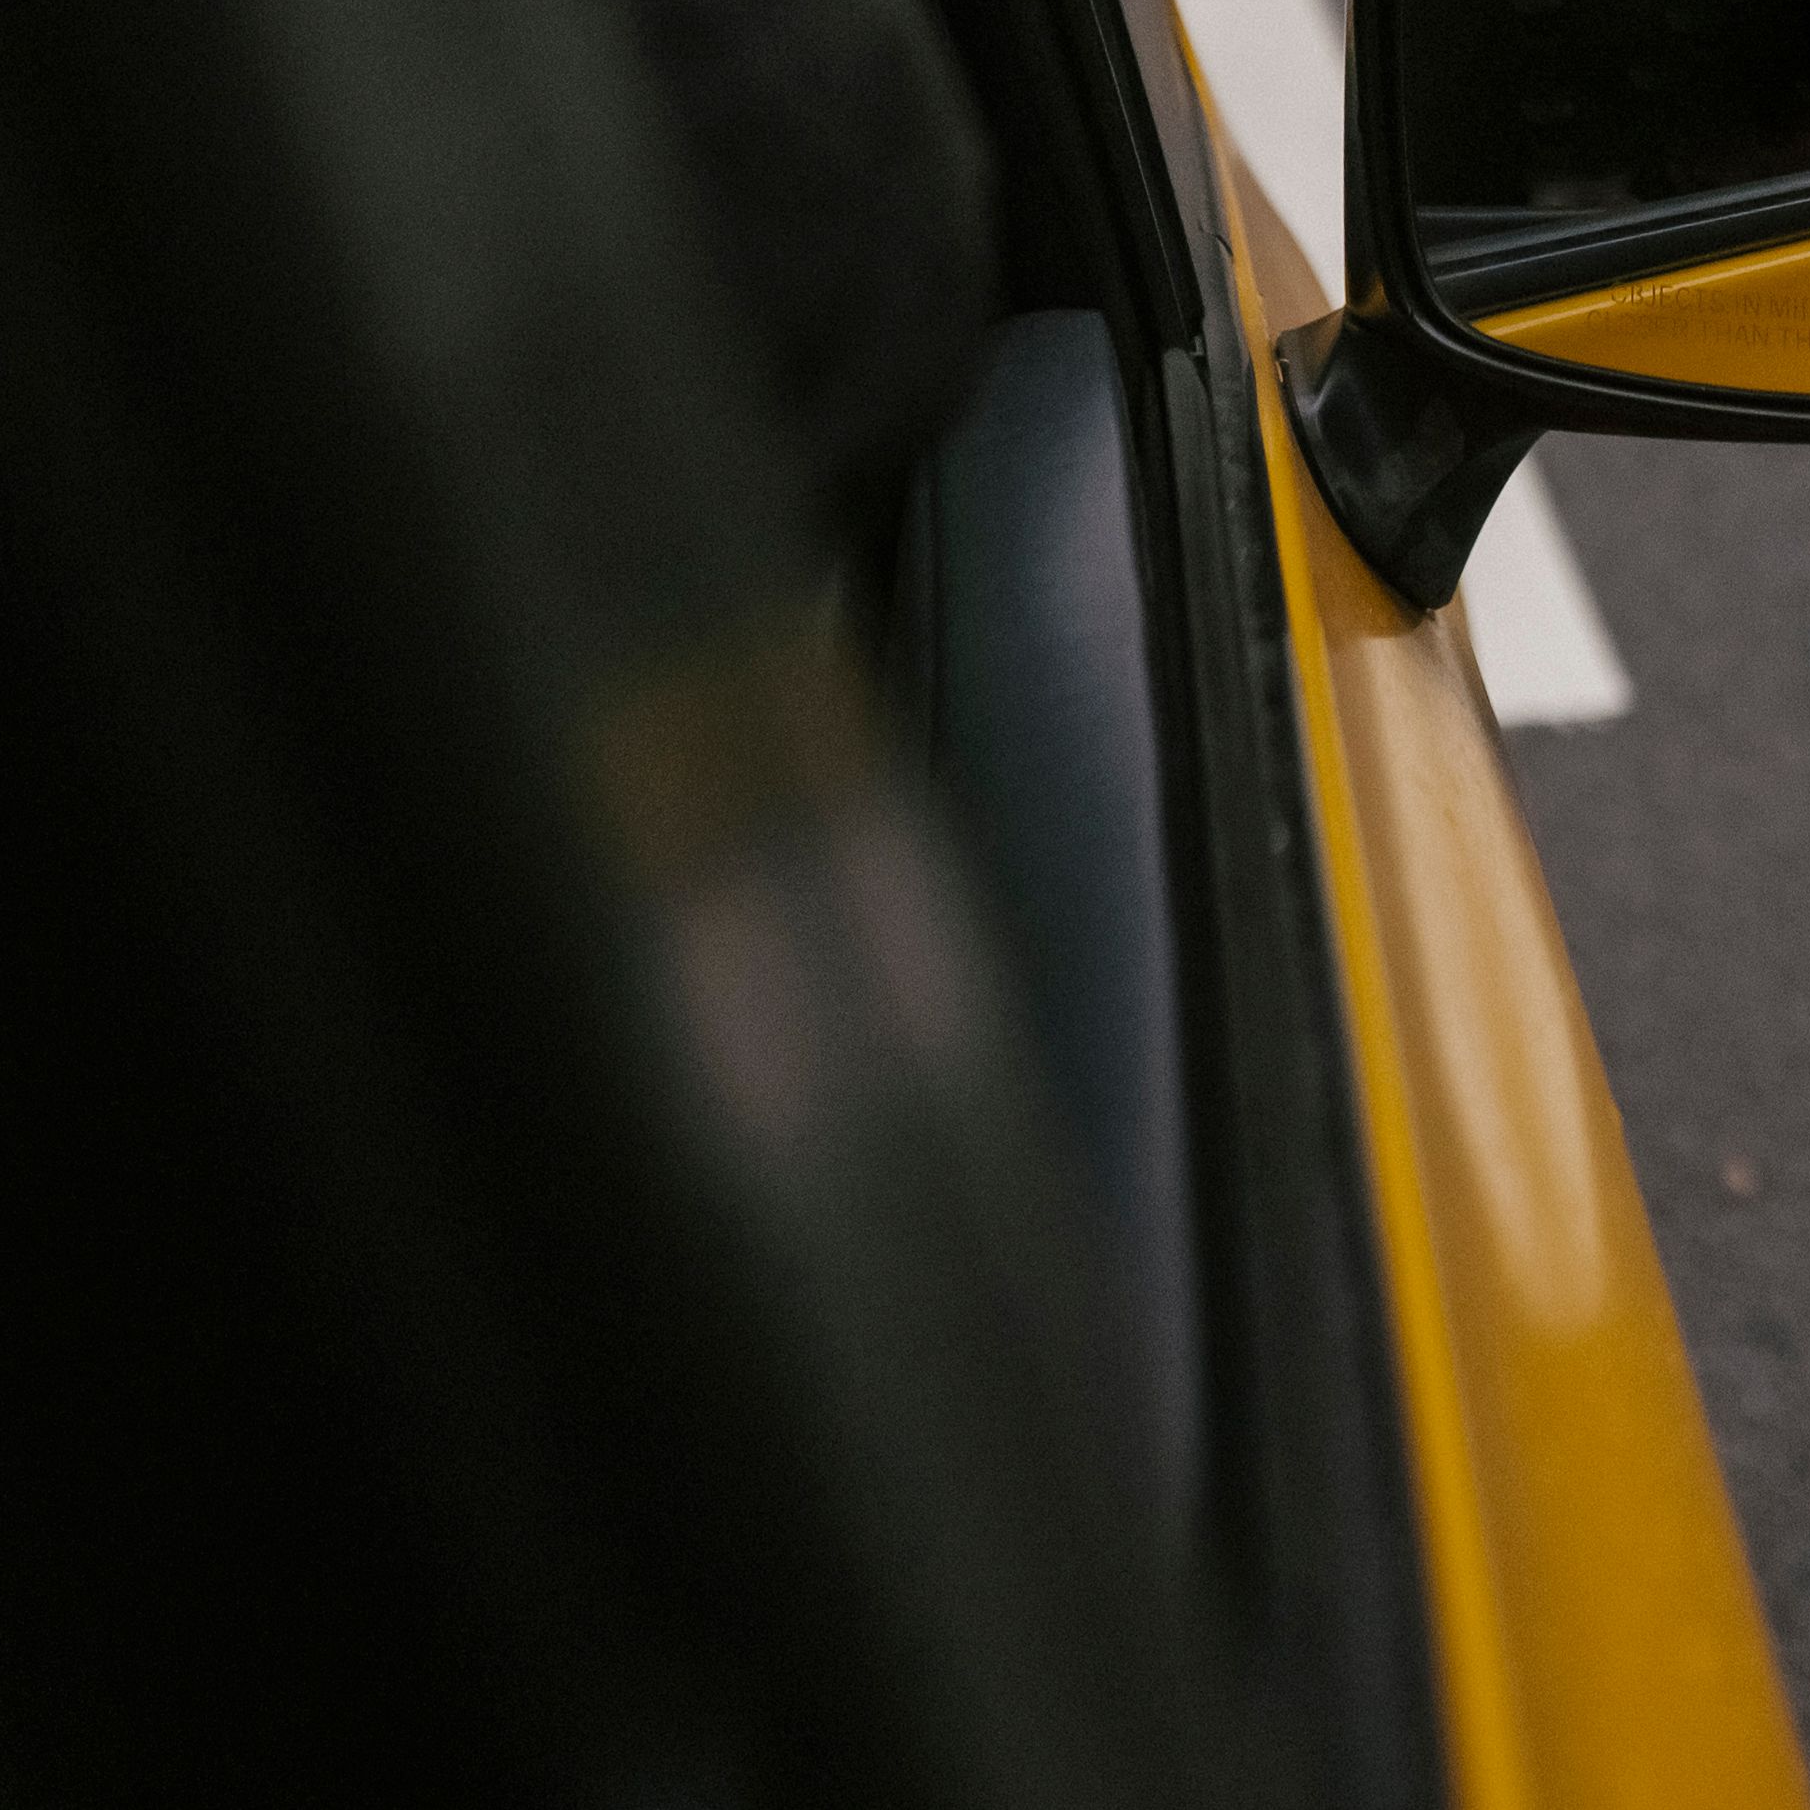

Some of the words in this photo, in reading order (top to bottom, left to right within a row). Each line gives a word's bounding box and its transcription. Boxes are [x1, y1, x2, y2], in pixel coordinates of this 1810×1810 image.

[1611, 283, 1726, 313] OBJECTS
[1735, 291, 1761, 317] IN
[1701, 319, 1770, 347] THAN
